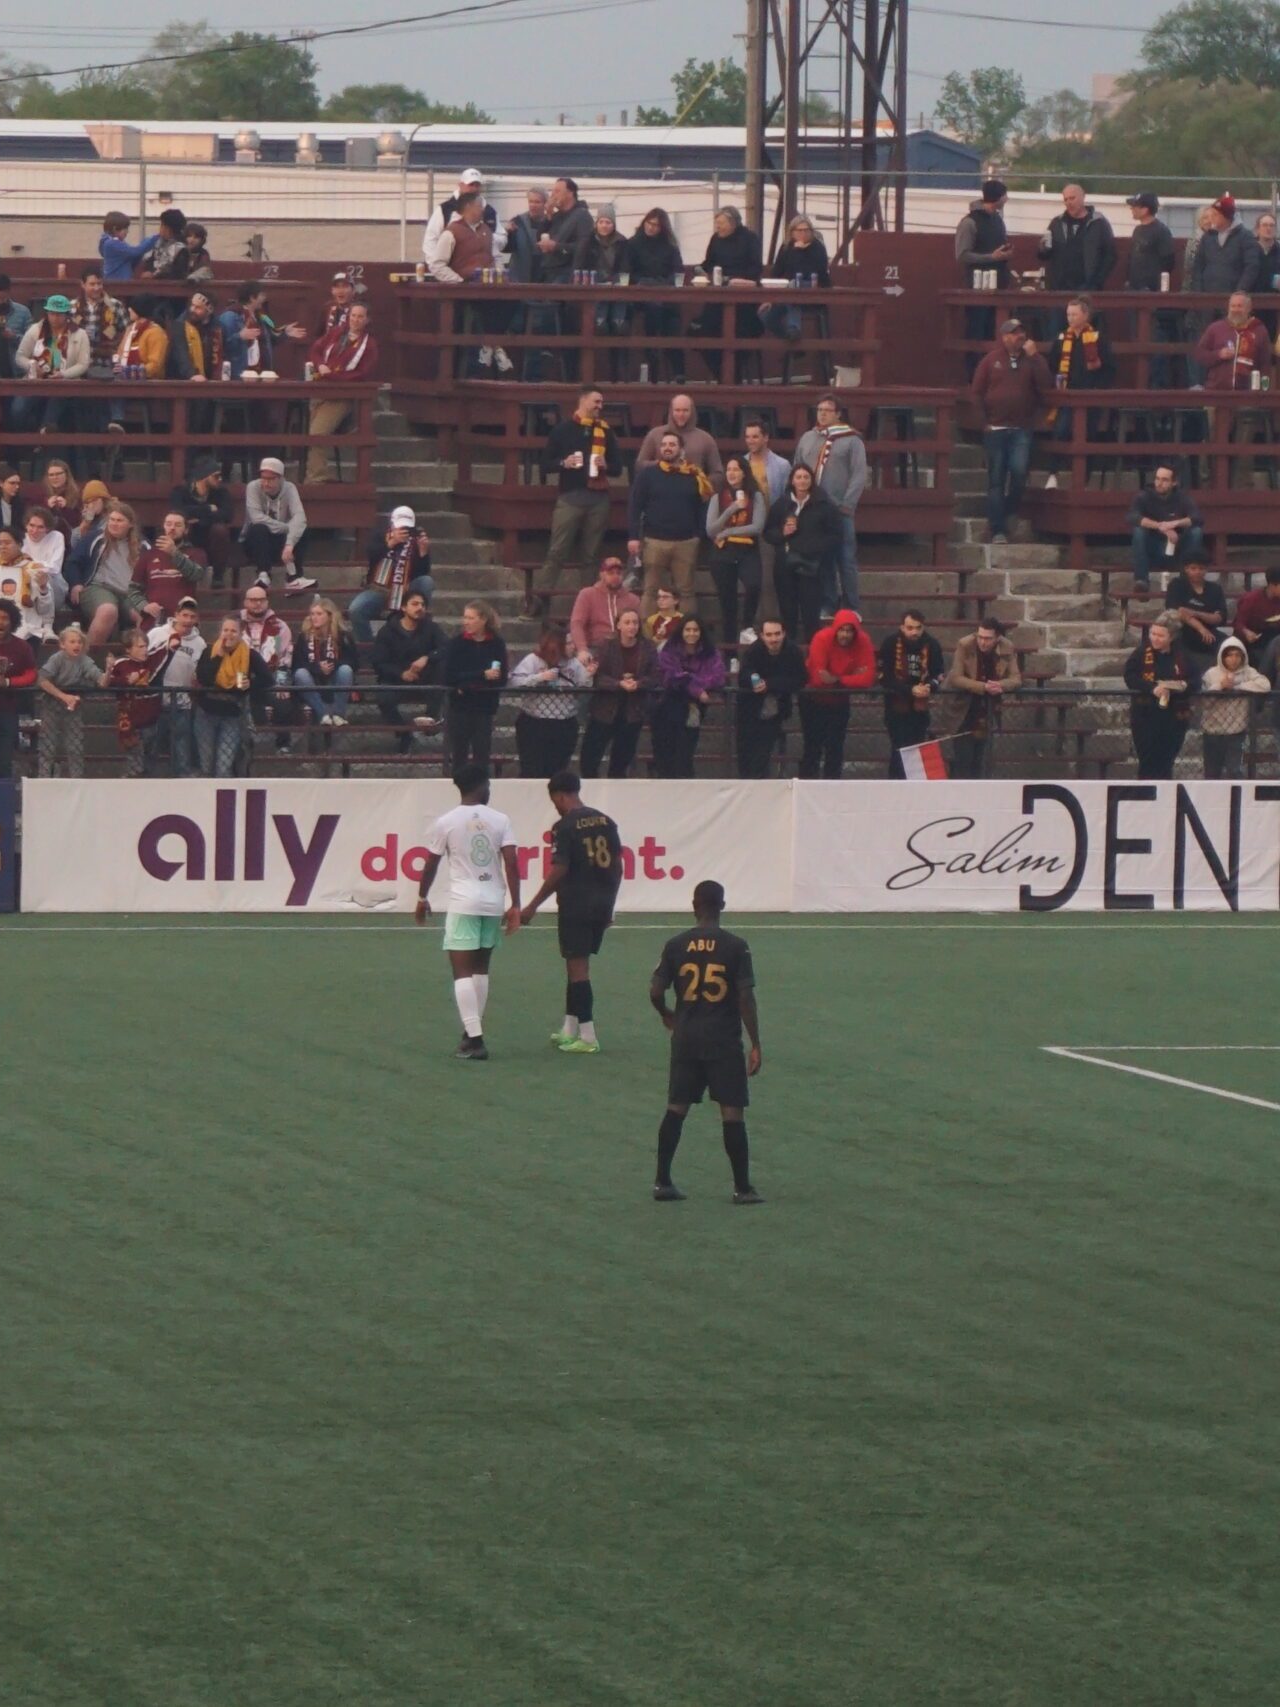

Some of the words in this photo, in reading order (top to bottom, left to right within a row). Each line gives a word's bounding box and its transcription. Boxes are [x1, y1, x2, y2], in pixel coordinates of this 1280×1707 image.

[884, 265, 900, 280] 21
[137, 789, 341, 906] ally
[470, 833, 494, 868] 8
[583, 835, 612, 869] 18
[886, 816, 1066, 890] Salim
[686, 938, 717, 952] ABU
[679, 962, 728, 1003] 25
